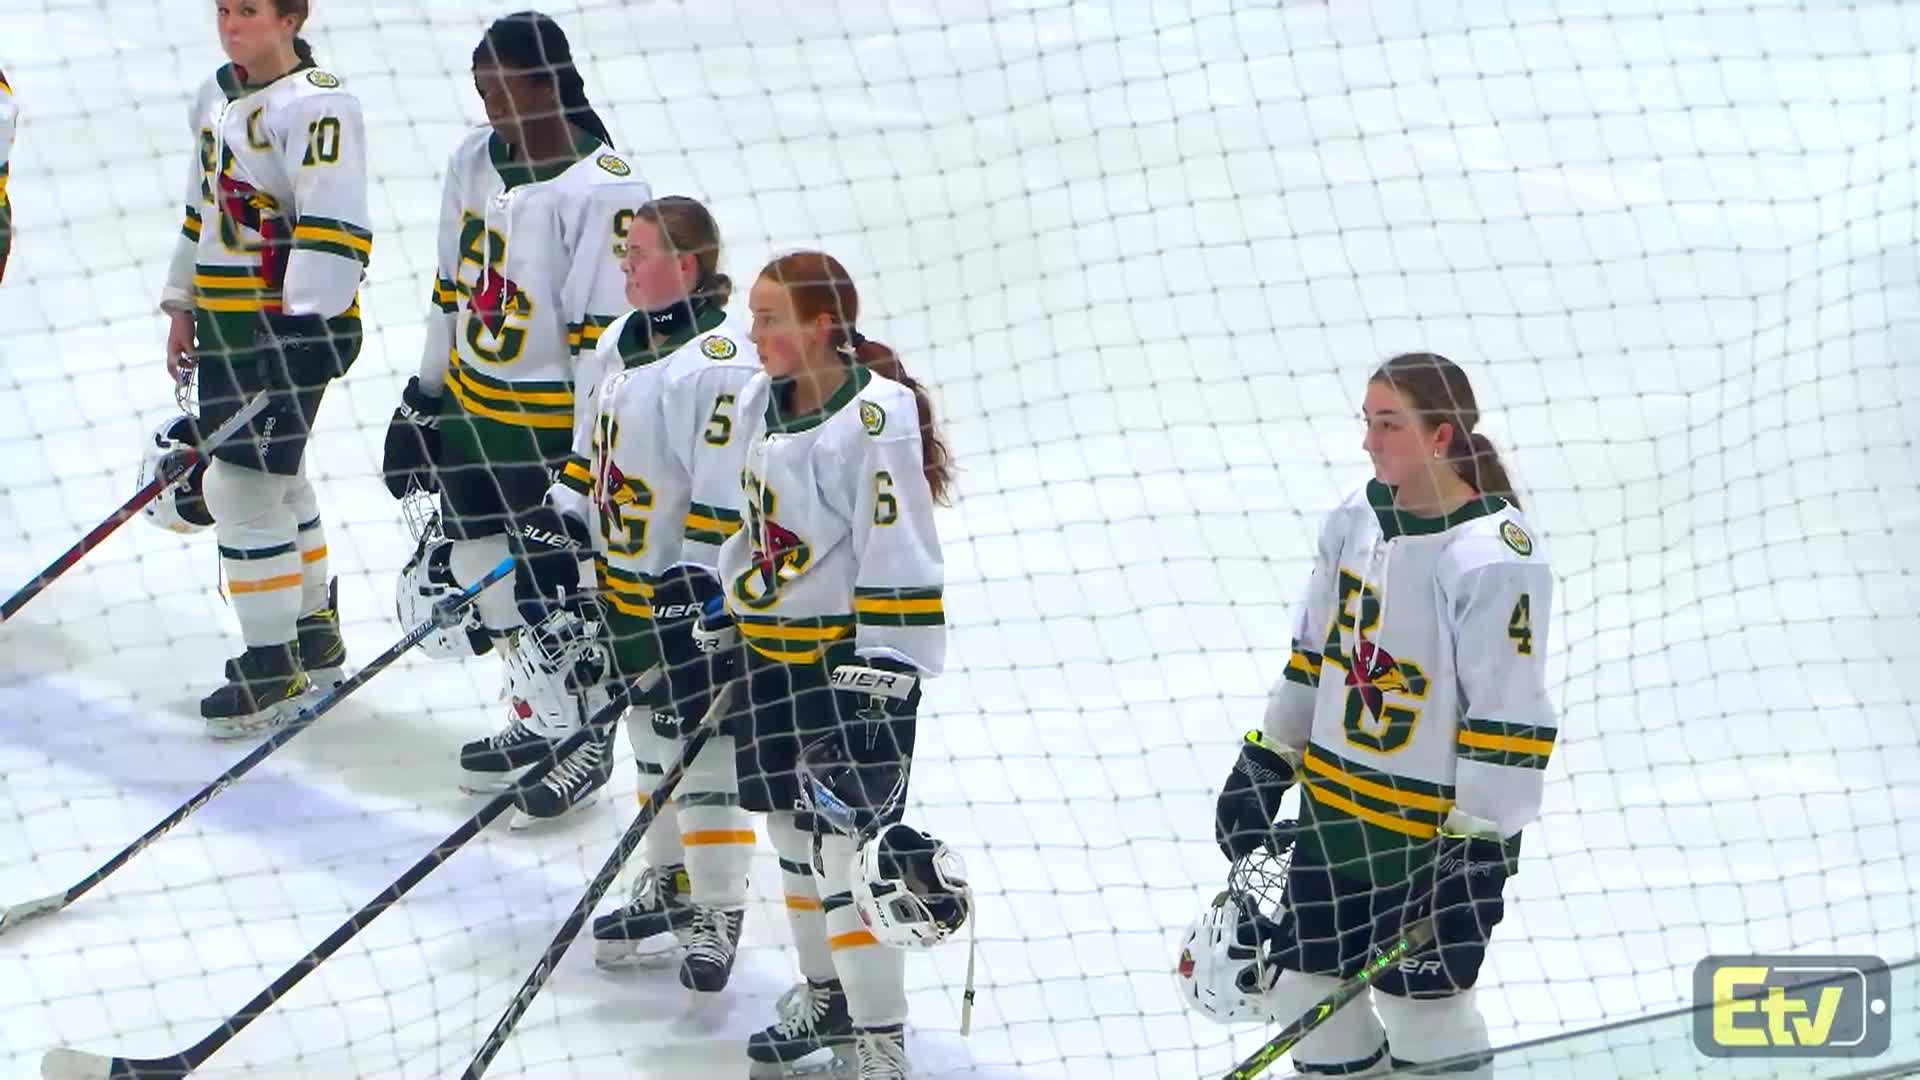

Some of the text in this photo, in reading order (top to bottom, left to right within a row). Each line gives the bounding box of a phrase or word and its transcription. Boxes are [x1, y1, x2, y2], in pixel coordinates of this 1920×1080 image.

[302, 115, 342, 167] 10
[703, 393, 735, 446] 5
[873, 469, 899, 528] 6
[1507, 592, 1533, 655] 4
[831, 671, 897, 689] AUER
